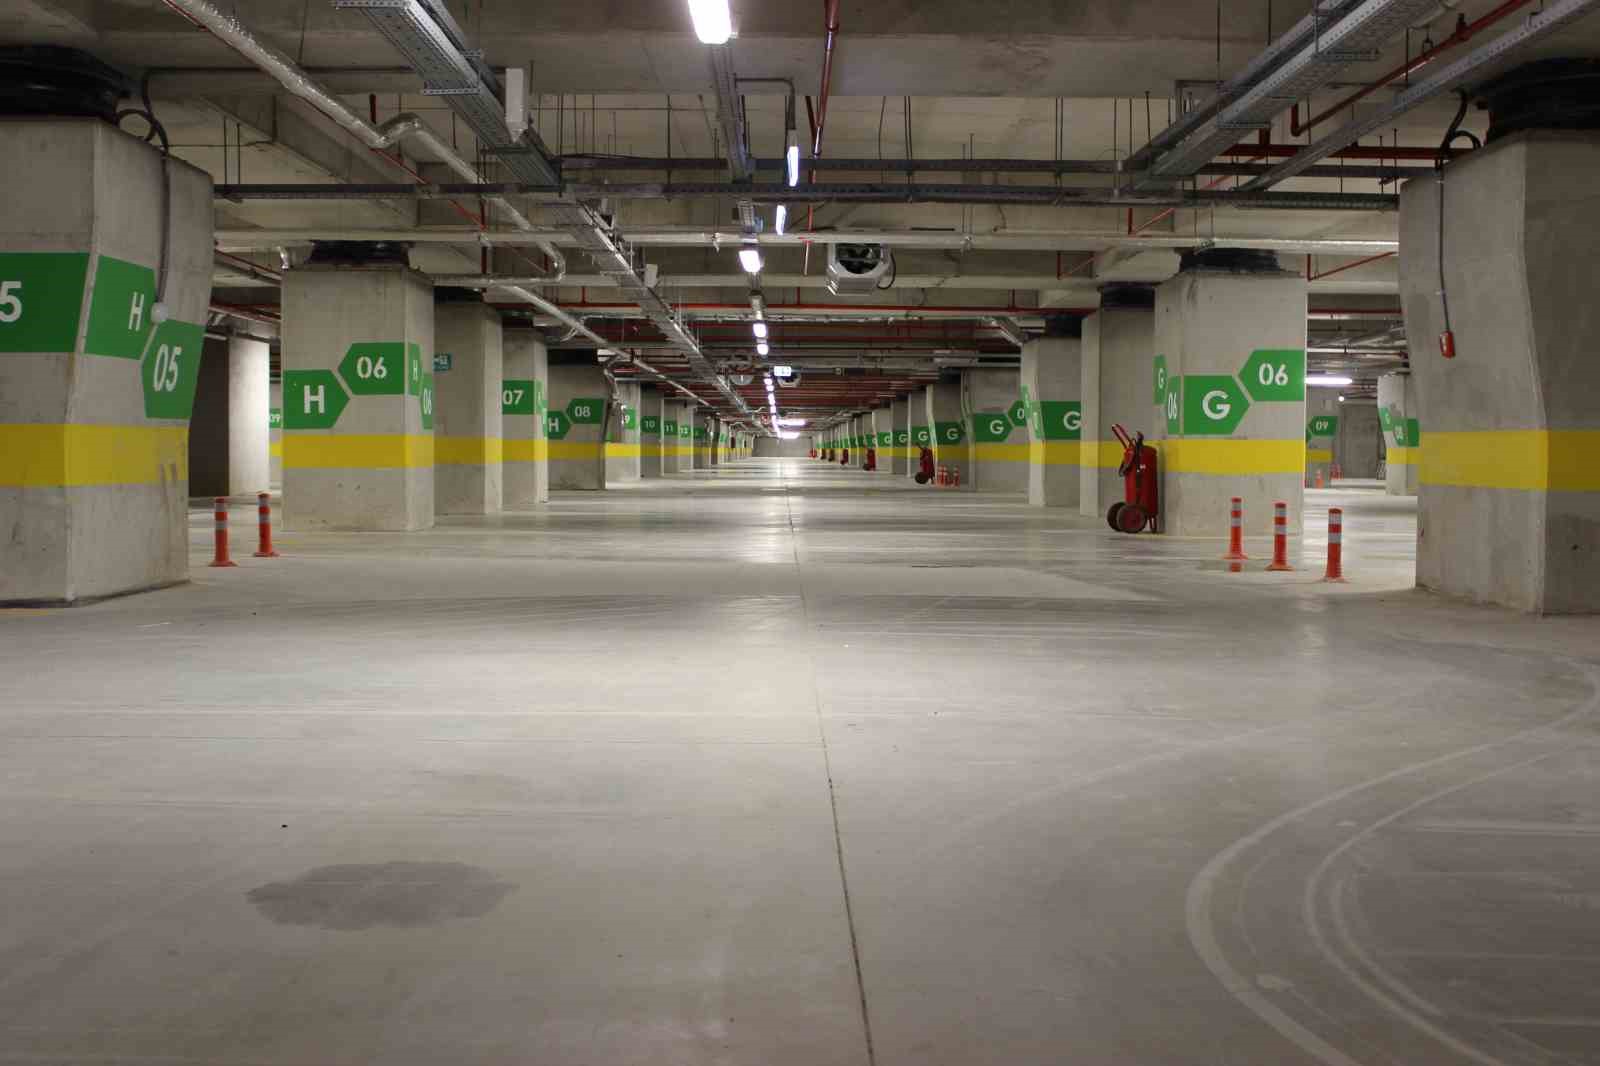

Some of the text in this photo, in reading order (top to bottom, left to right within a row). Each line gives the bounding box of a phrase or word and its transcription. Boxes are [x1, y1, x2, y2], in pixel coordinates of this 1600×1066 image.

[128, 291, 145, 331] H
[153, 344, 182, 391] 05
[356, 356, 387, 379] 06
[1258, 363, 1289, 385] 06
[1157, 369, 1165, 389] G
[303, 384, 325, 414] H
[423, 388, 432, 415] 06
[502, 389, 524, 405] 07
[1167, 391, 1177, 420] 06
[1202, 390, 1231, 420] G
[574, 406, 591, 417] 08
[1062, 411, 1081, 430] G
[548, 417, 560, 433] H
[645, 420, 656, 429] 10
[946, 428, 960, 440] G
[990, 420, 1004, 434] G
[918, 431, 929, 441] G
